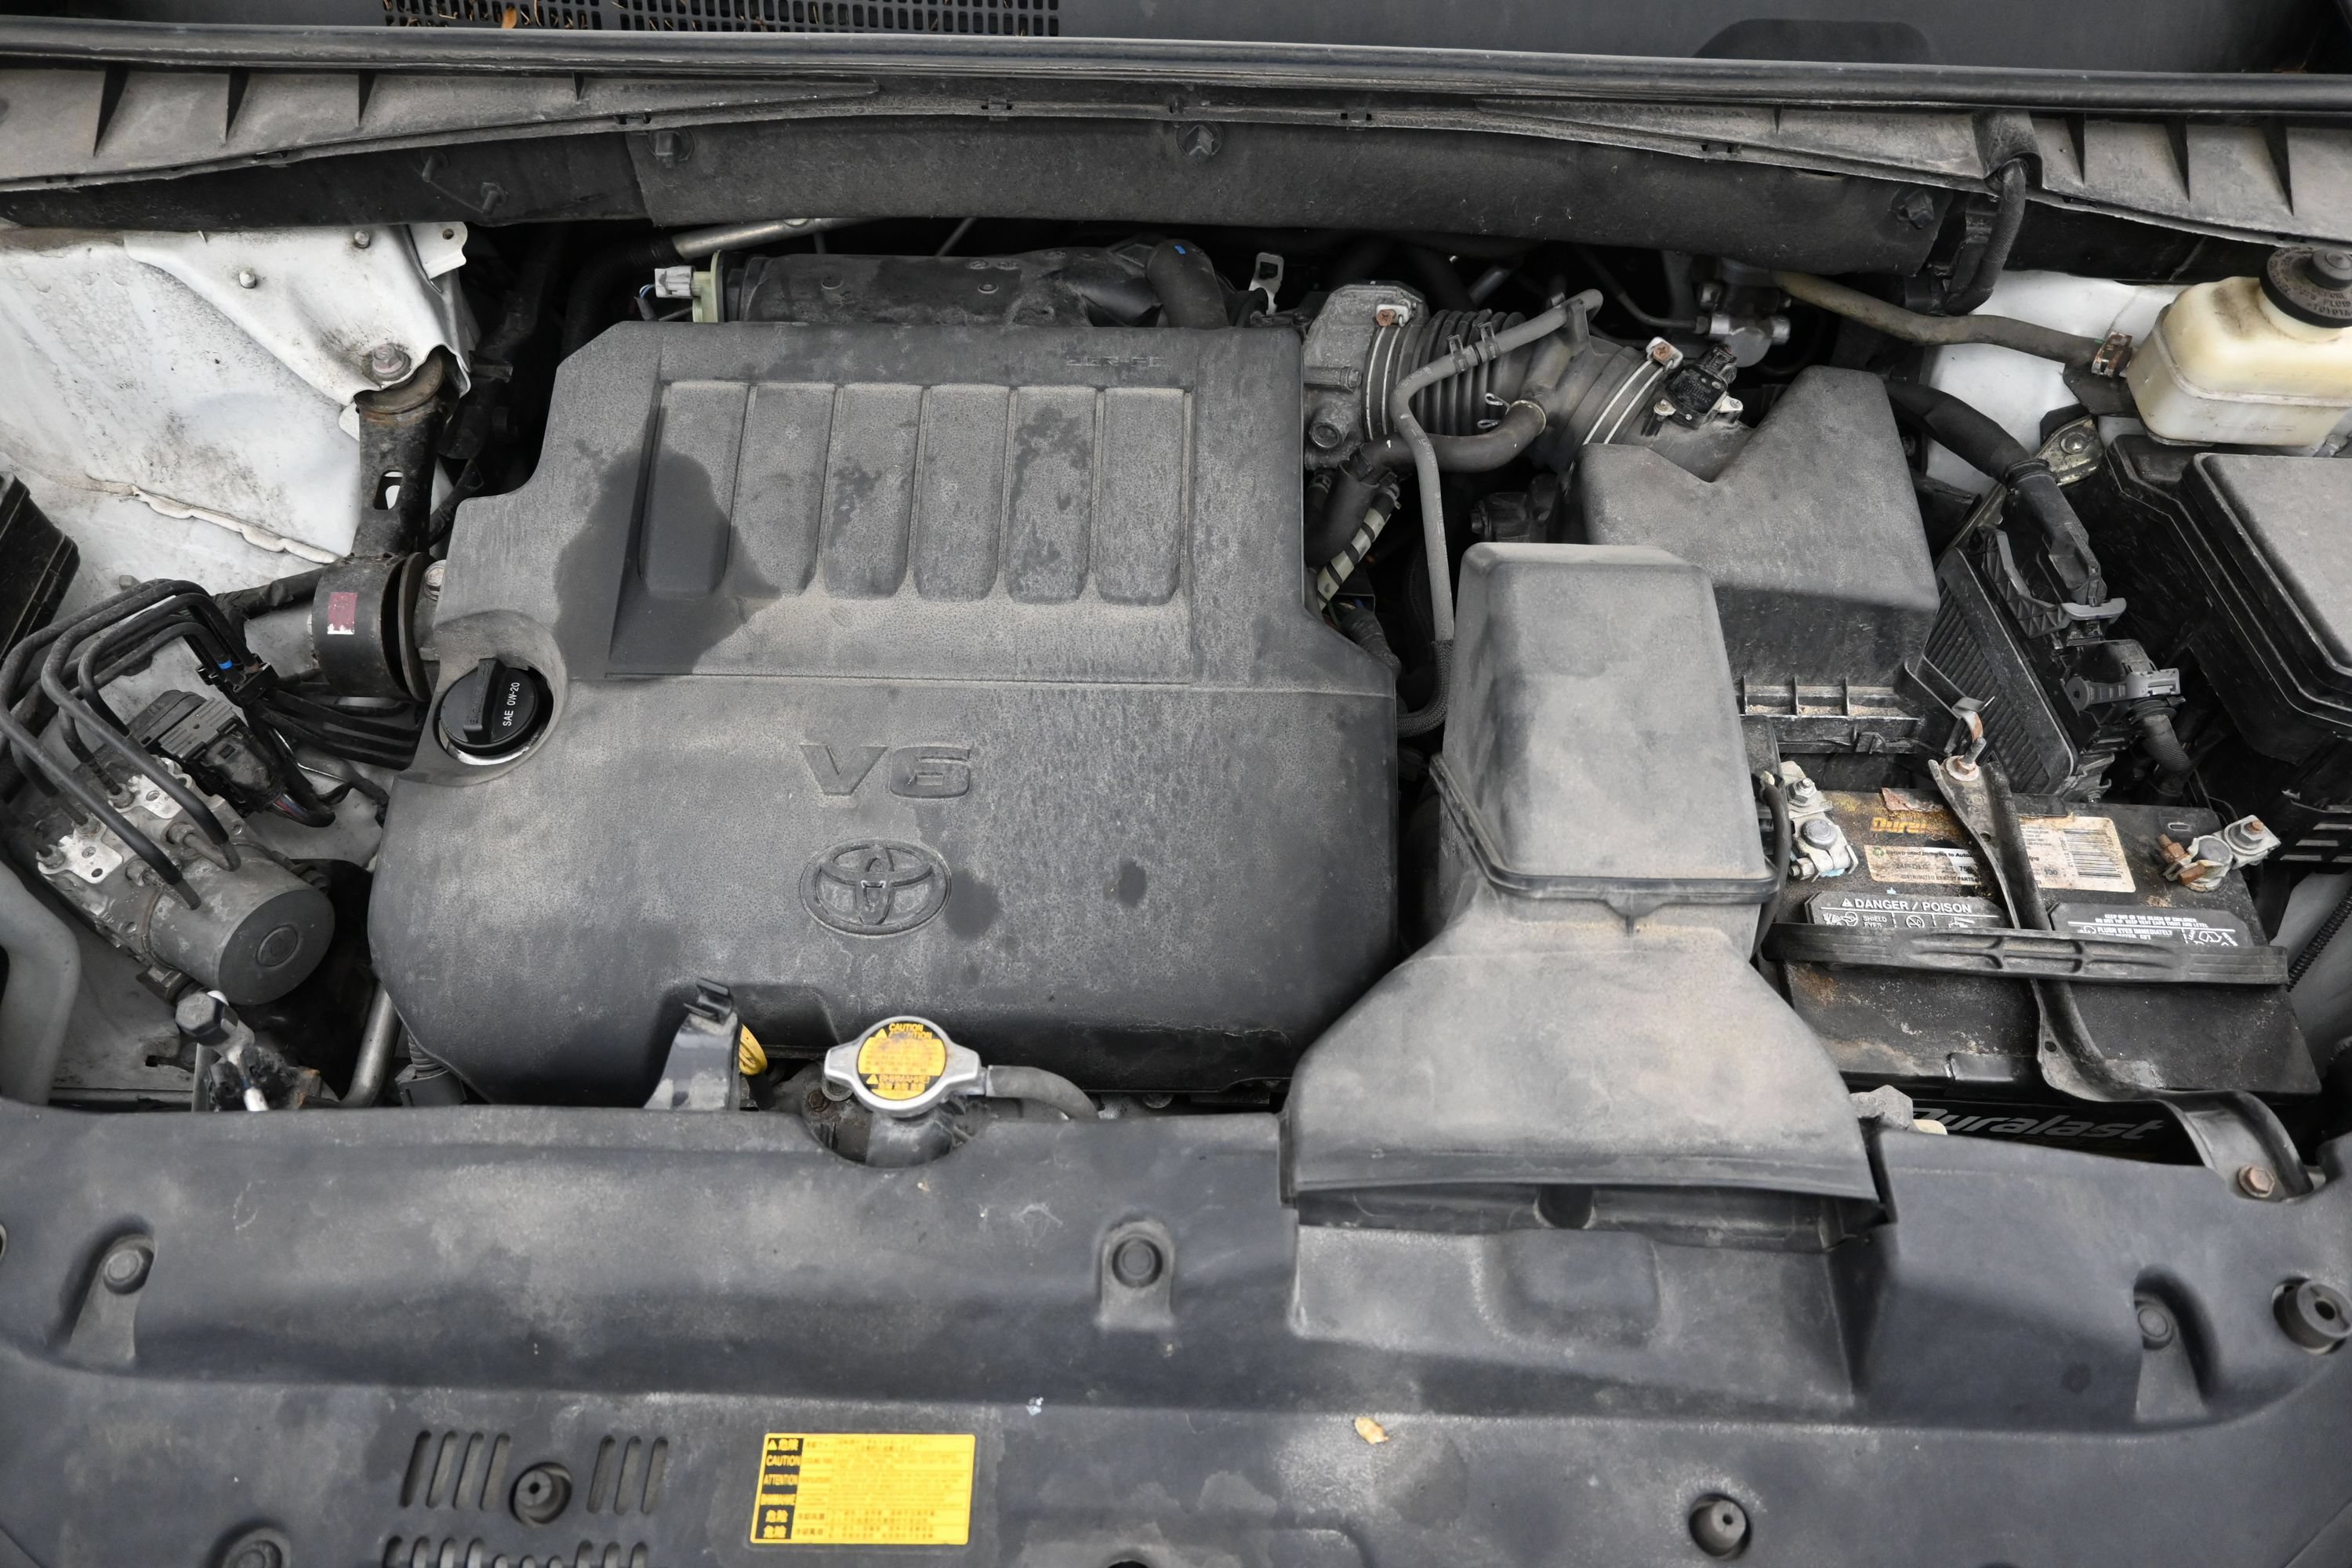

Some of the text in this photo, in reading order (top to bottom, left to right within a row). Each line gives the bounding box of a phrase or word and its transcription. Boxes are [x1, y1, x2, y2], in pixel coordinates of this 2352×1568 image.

[503, 682, 520, 726] SAE 0W-20
[797, 744, 971, 799] V6
[1855, 898, 1972, 913] DANGER / POISON
[888, 1023, 924, 1033] CAUTION
[766, 1454, 800, 1467] CAUTION
[763, 1474, 798, 1486] ATTENTION
